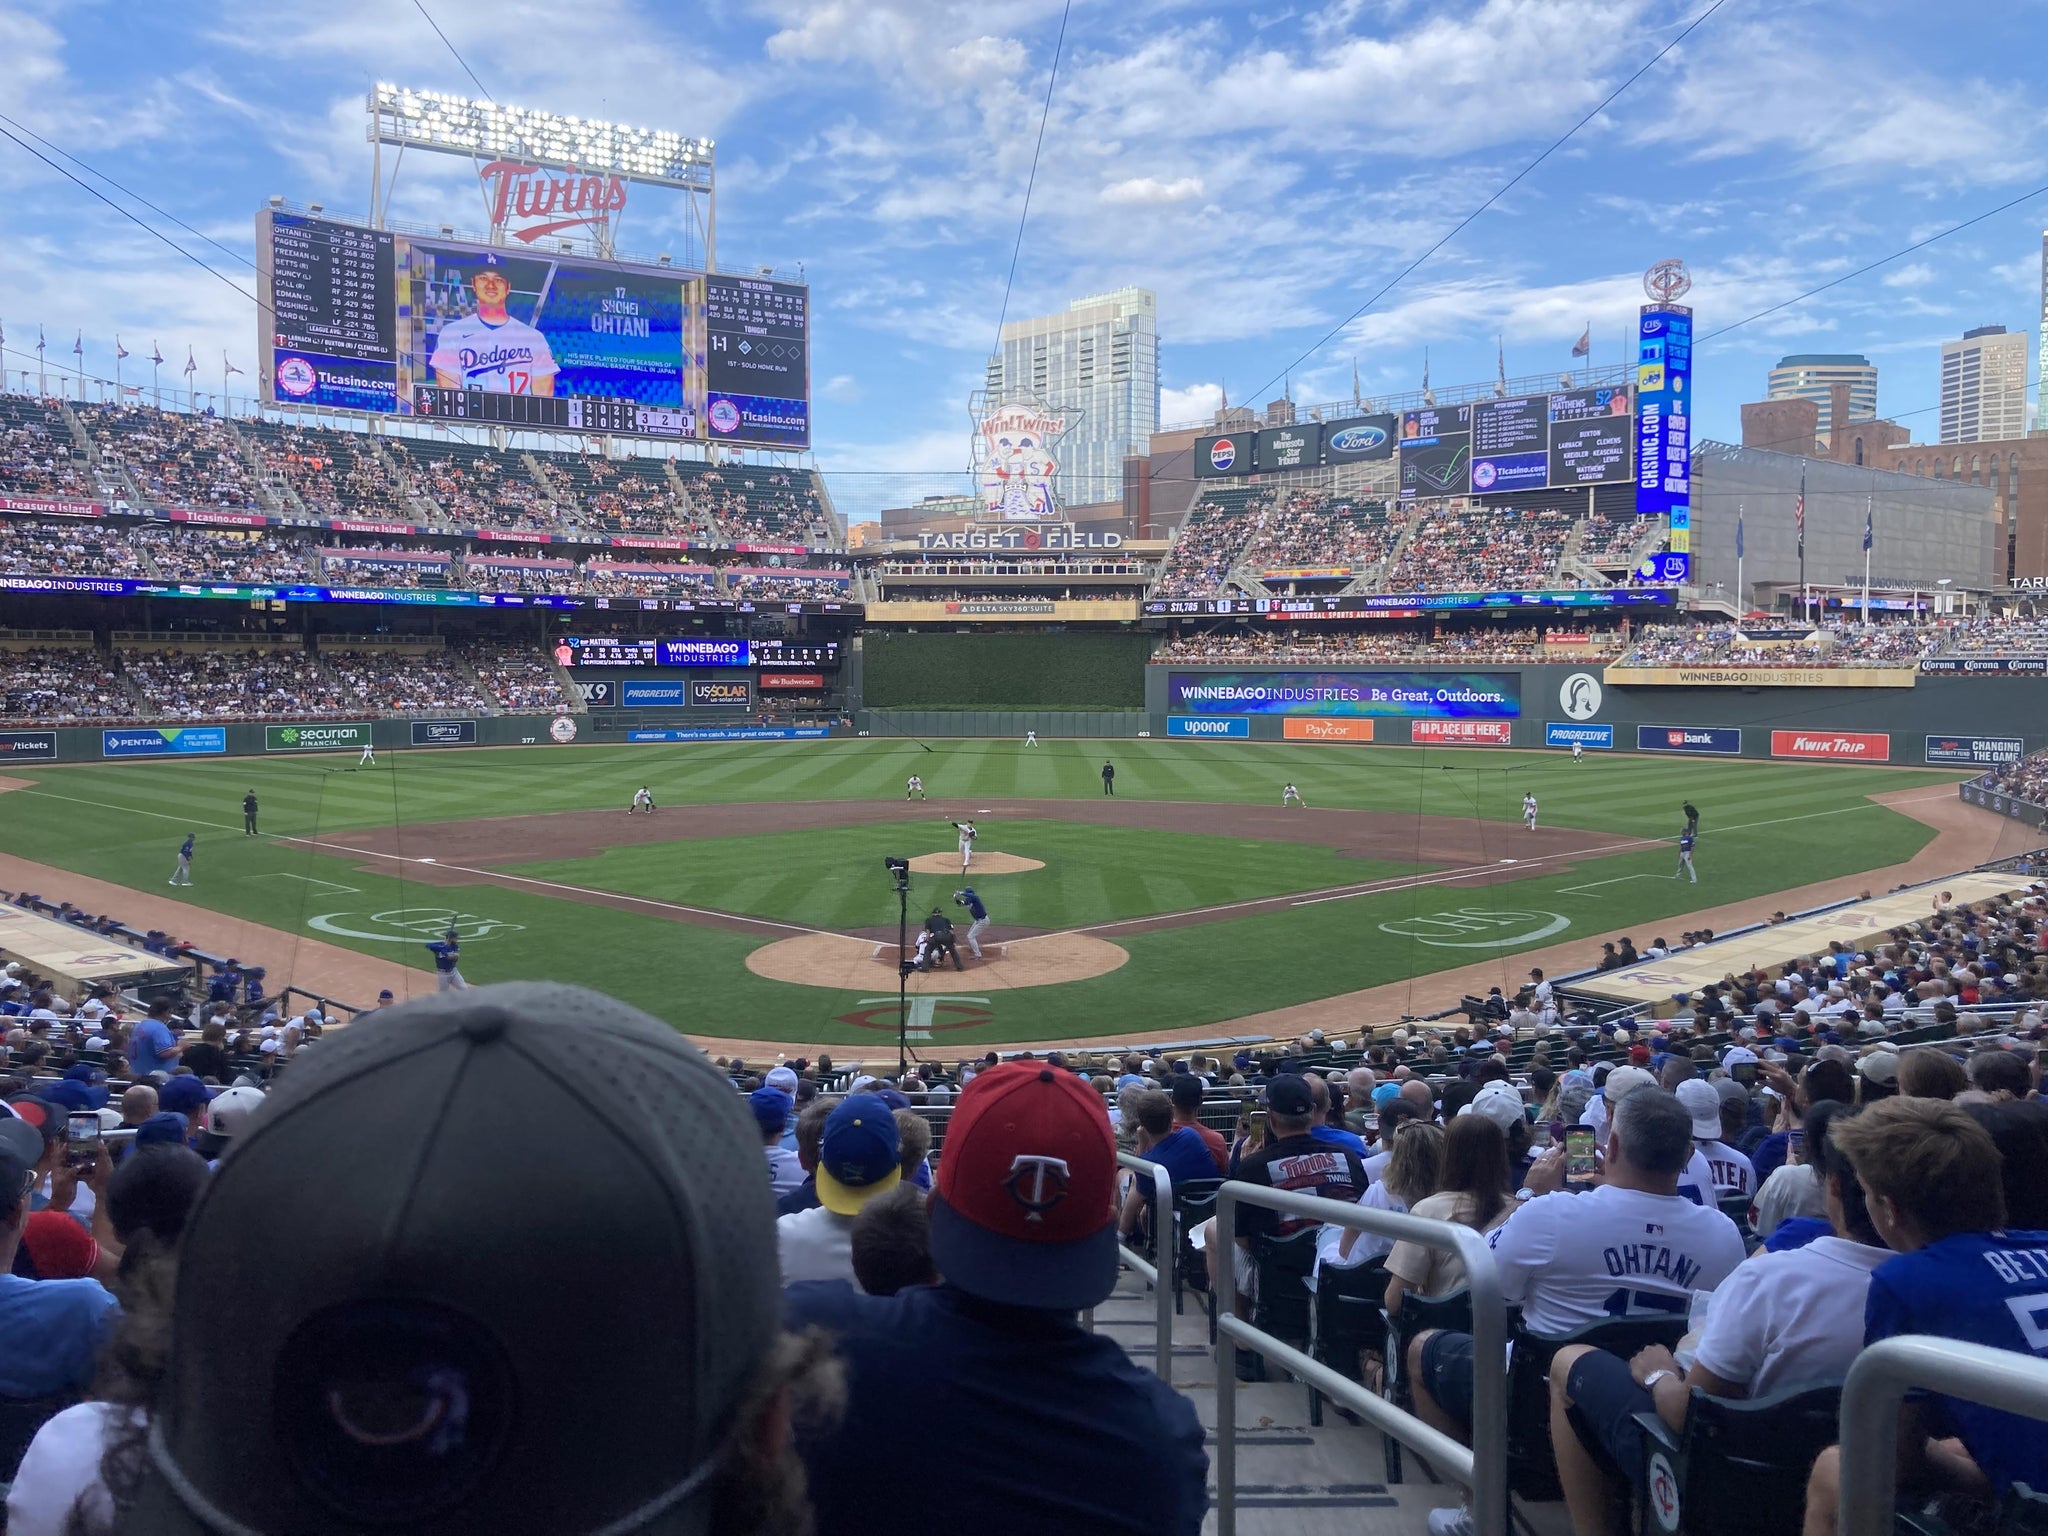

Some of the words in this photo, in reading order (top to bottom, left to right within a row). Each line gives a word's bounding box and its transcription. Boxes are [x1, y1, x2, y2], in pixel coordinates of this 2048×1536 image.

[481, 160, 627, 225] Twins
[275, 227, 301, 236] OHTANI
[275, 237, 298, 246] PAGES
[275, 247, 309, 259] FREEMAN
[275, 259, 298, 267] BETTS
[275, 269, 301, 278] MUNCY
[276, 280, 294, 288] CALL
[739, 281, 751, 289] THIS
[752, 282, 773, 291] SEASON
[276, 290, 302, 299] EDMAN
[615, 287, 626, 299] 17
[276, 301, 308, 311] RUSHING
[602, 299, 638, 315] SHOHEI
[276, 311, 297, 319] WARD
[591, 313, 650, 338] OHTANI
[744, 326, 767, 335] TONIGHT
[712, 336, 727, 351] 1-1
[459, 345, 533, 375] Dodgers
[595, 355, 618, 363] PLAYED
[636, 359, 663, 367] SEASONS
[564, 358, 608, 368] PROFESSIONAL
[611, 363, 648, 372] BASKETBALL
[657, 367, 676, 375] JAPAN
[508, 371, 529, 394] 17
[1596, 390, 1612, 405] 52
[1458, 407, 1469, 422] 17
[981, 415, 1014, 436] Win!
[1016, 415, 1066, 434] Twins!
[1280, 432, 1291, 440] The
[1341, 432, 1374, 449] Ford
[1273, 439, 1305, 449] Minnesota
[1641, 403, 1660, 489] CHSINC.COM
[1212, 451, 1234, 459] PEPSI
[1287, 448, 1300, 457] Star
[1278, 455, 1300, 466] Tribune
[6, 499, 56, 513] Treasure
[58, 503, 92, 514] Island
[341, 522, 380, 532] Treasure
[382, 524, 407, 534] Island
[620, 539, 655, 547] Treasure
[656, 541, 681, 549] Island
[918, 533, 1020, 548] TARGET
[1046, 532, 1122, 548] FIELD
[1666, 558, 1684, 571] CHS
[2010, 577, 2048, 588] TAR
[1290, 611, 1326, 619] UNIVERSAL
[1328, 611, 1350, 619] SPORTS
[1351, 610, 1389, 618] AUCTIONS
[568, 638, 579, 648] 52
[666, 642, 739, 654] WINNEBAGO
[751, 641, 759, 649] 33
[669, 654, 738, 662] INDUSTRIES
[1922, 660, 1955, 671] Corona
[1964, 661, 1999, 671] Corona
[2008, 660, 2044, 670] Corona
[596, 684, 607, 699] 9
[627, 689, 681, 698] PROGRESSIVE
[1371, 688, 1387, 701] Be
[1392, 688, 1433, 704] Great,
[1436, 689, 1505, 703] Outdoors.
[1184, 720, 1230, 734] uponor
[1305, 720, 1349, 736] Paycor
[1431, 723, 1460, 734] PLACE
[1461, 724, 1475, 735] LIKE
[1477, 724, 1501, 735] HERE
[300, 727, 358, 740] securian
[1550, 729, 1610, 742] PROGRESSIVE
[1684, 732, 1713, 743] bank
[120, 738, 163, 747] PENTAIR
[1972, 741, 2020, 751] CHANGING
[1973, 751, 1991, 761] THE
[1993, 752, 2018, 761] GAME
[1279, 1152, 1337, 1180] Twins
[1326, 1174, 1352, 1183] TWINS
[1603, 1244, 1702, 1289] OHTANI
